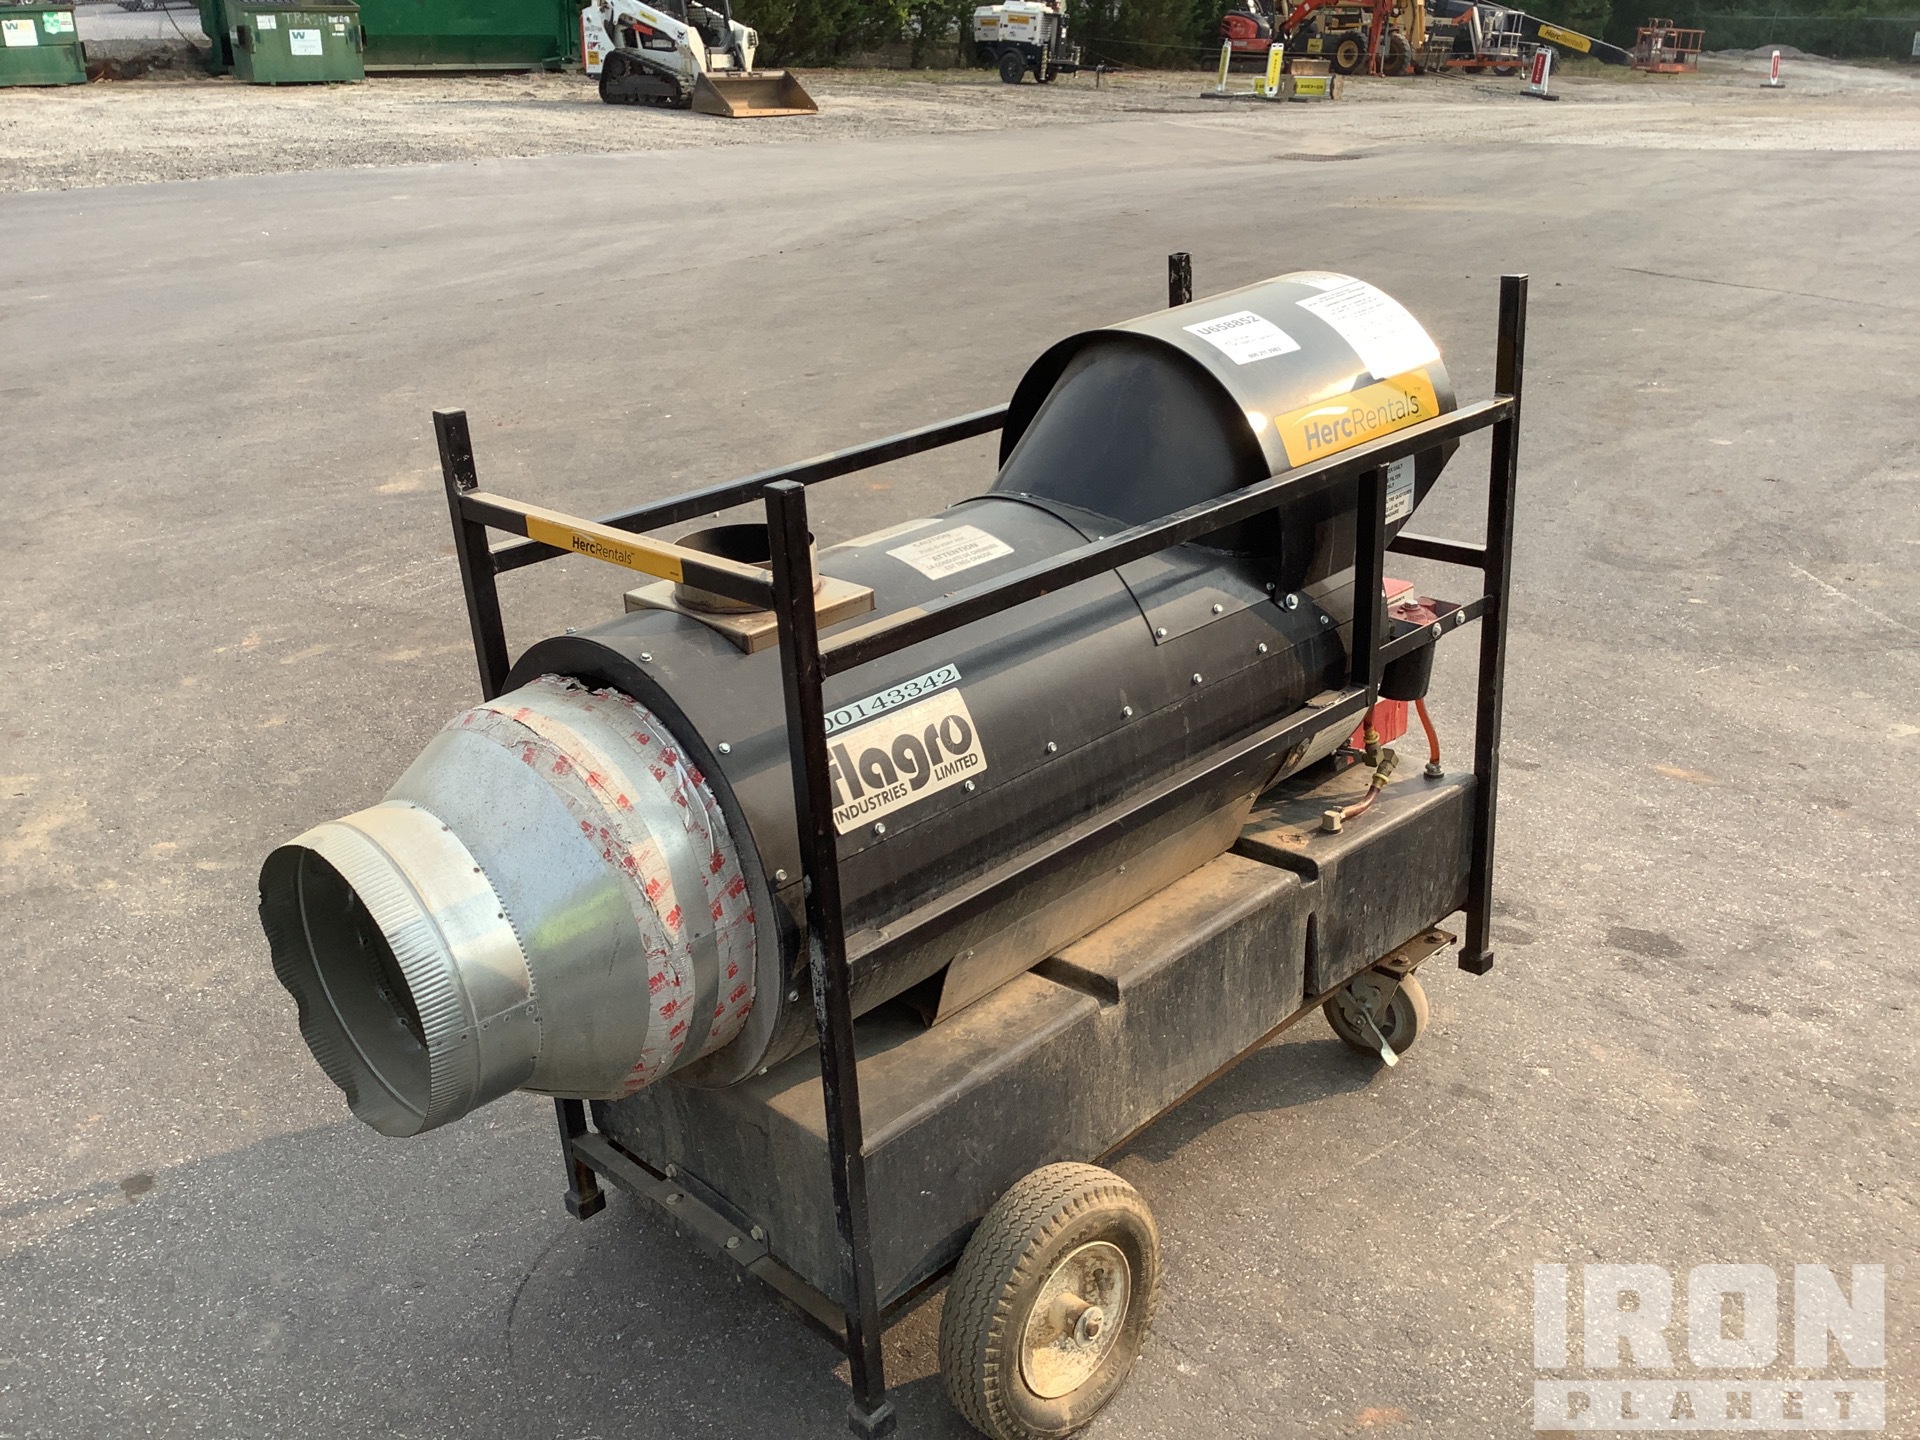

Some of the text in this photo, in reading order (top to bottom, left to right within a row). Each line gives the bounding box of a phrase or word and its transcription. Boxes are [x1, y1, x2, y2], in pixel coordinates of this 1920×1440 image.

[281, 12, 328, 26] TRASH
[1197, 315, 1260, 335] U658852
[572, 535, 632, 565] HercRentals
[932, 542, 979, 562] ATTENTION
[834, 752, 979, 826] INDUSTRIES LIMITED
